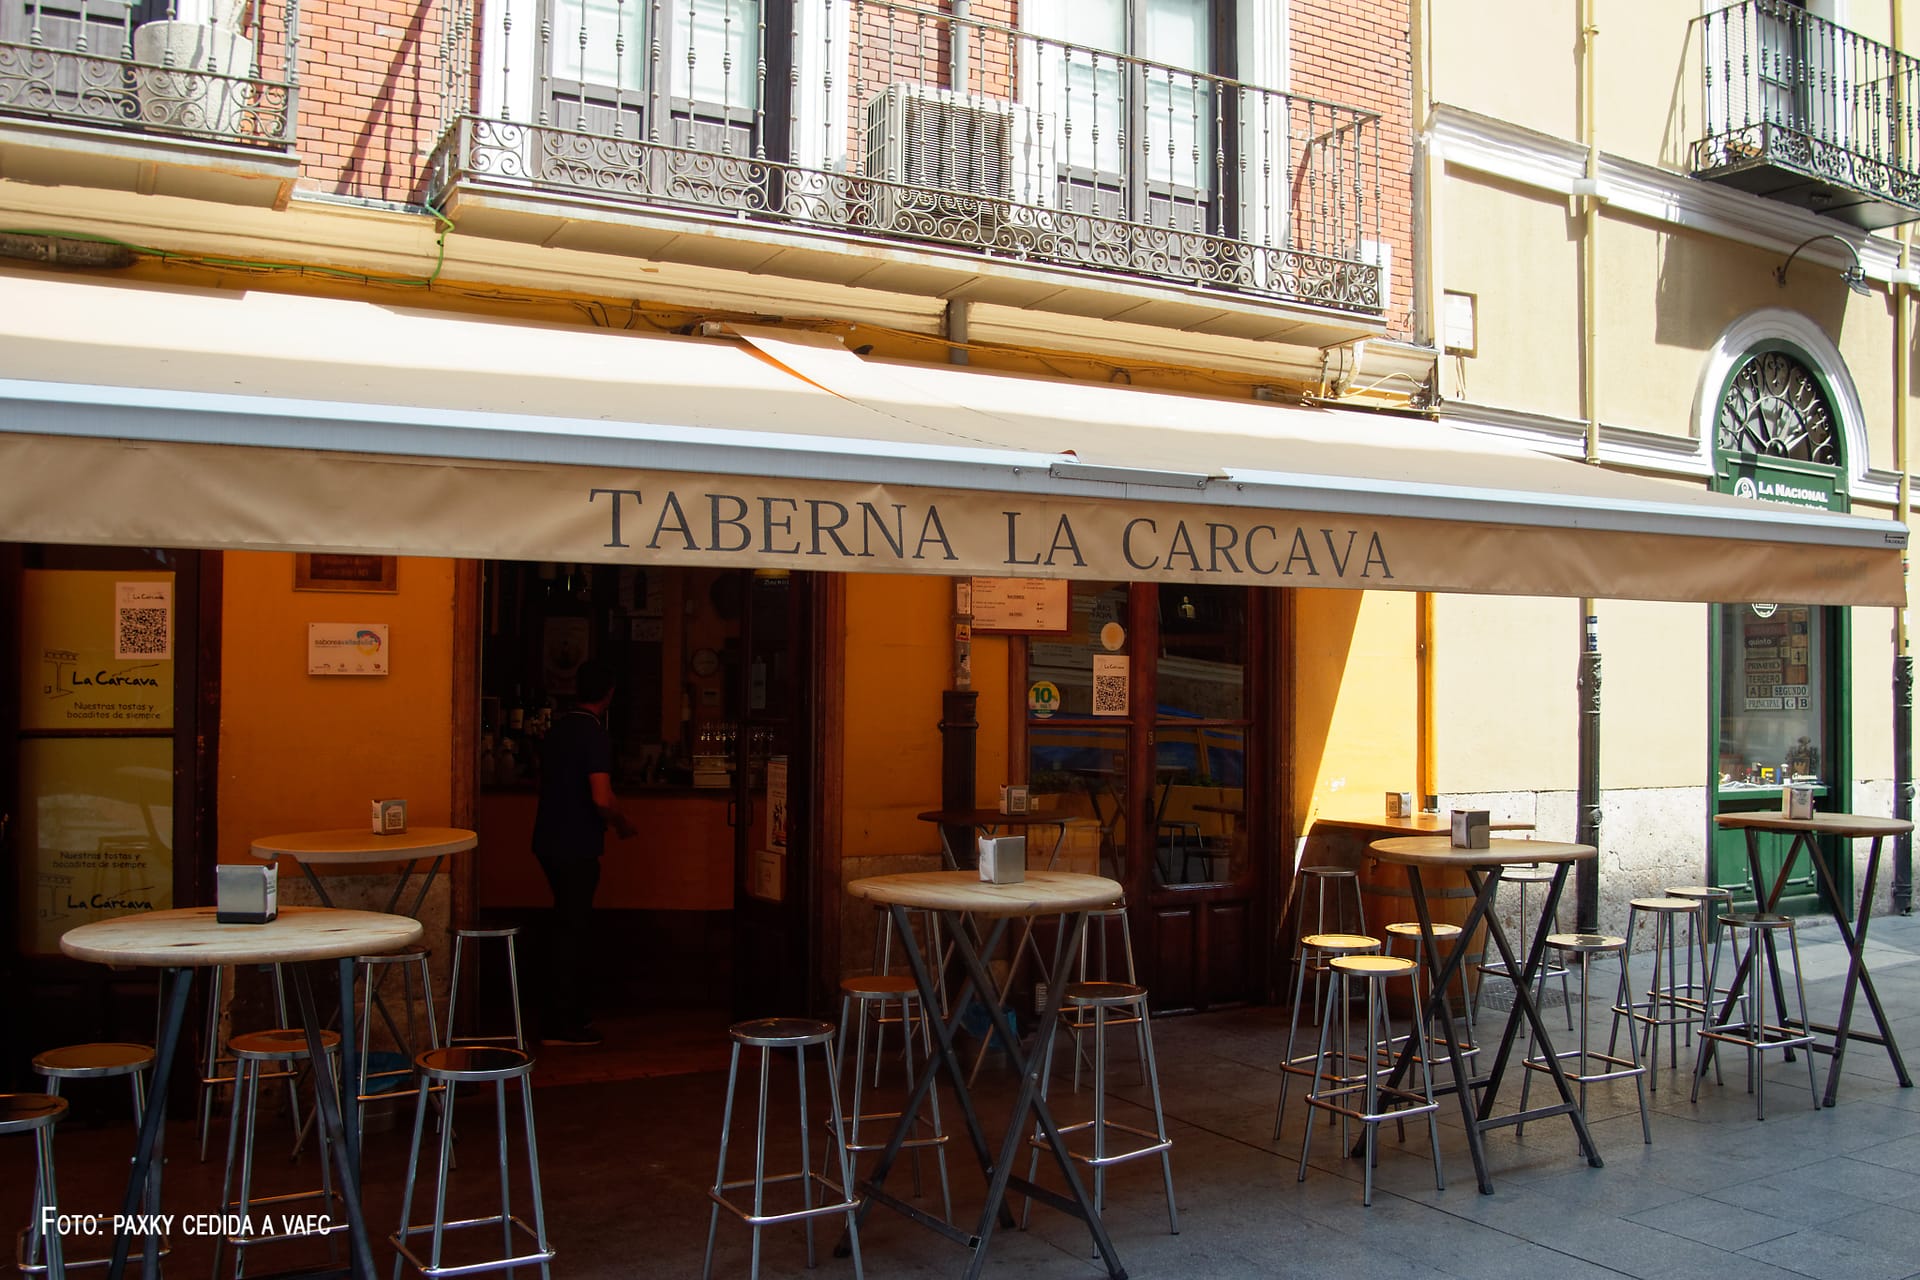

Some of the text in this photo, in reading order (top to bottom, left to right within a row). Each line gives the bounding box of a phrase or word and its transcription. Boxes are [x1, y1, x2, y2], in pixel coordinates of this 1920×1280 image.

[1758, 481, 1829, 503] LA NACIONAL
[589, 488, 1395, 579] TABERNA LA CARCAVA
[1748, 638, 1773, 647] quinto
[1747, 661, 1781, 671] PRIMERO
[72, 671, 93, 686] La
[1747, 674, 1781, 684] TERCERO
[1033, 687, 1053, 703] 10
[1749, 687, 1757, 696] A
[1774, 686, 1807, 696] SEGUNDO
[74, 701, 154, 712] Nuestras tostas y
[1747, 698, 1780, 708] PRINCIPAL
[1785, 698, 1794, 708] G
[1799, 698, 1809, 707] B
[66, 711, 161, 720] bocaditos de siempre
[60, 851, 101, 861] Nuestras
[104, 852, 132, 860] tostas
[52, 861, 96, 869] bocaditos
[112, 861, 147, 870] siempre
[67, 894, 88, 909] La
